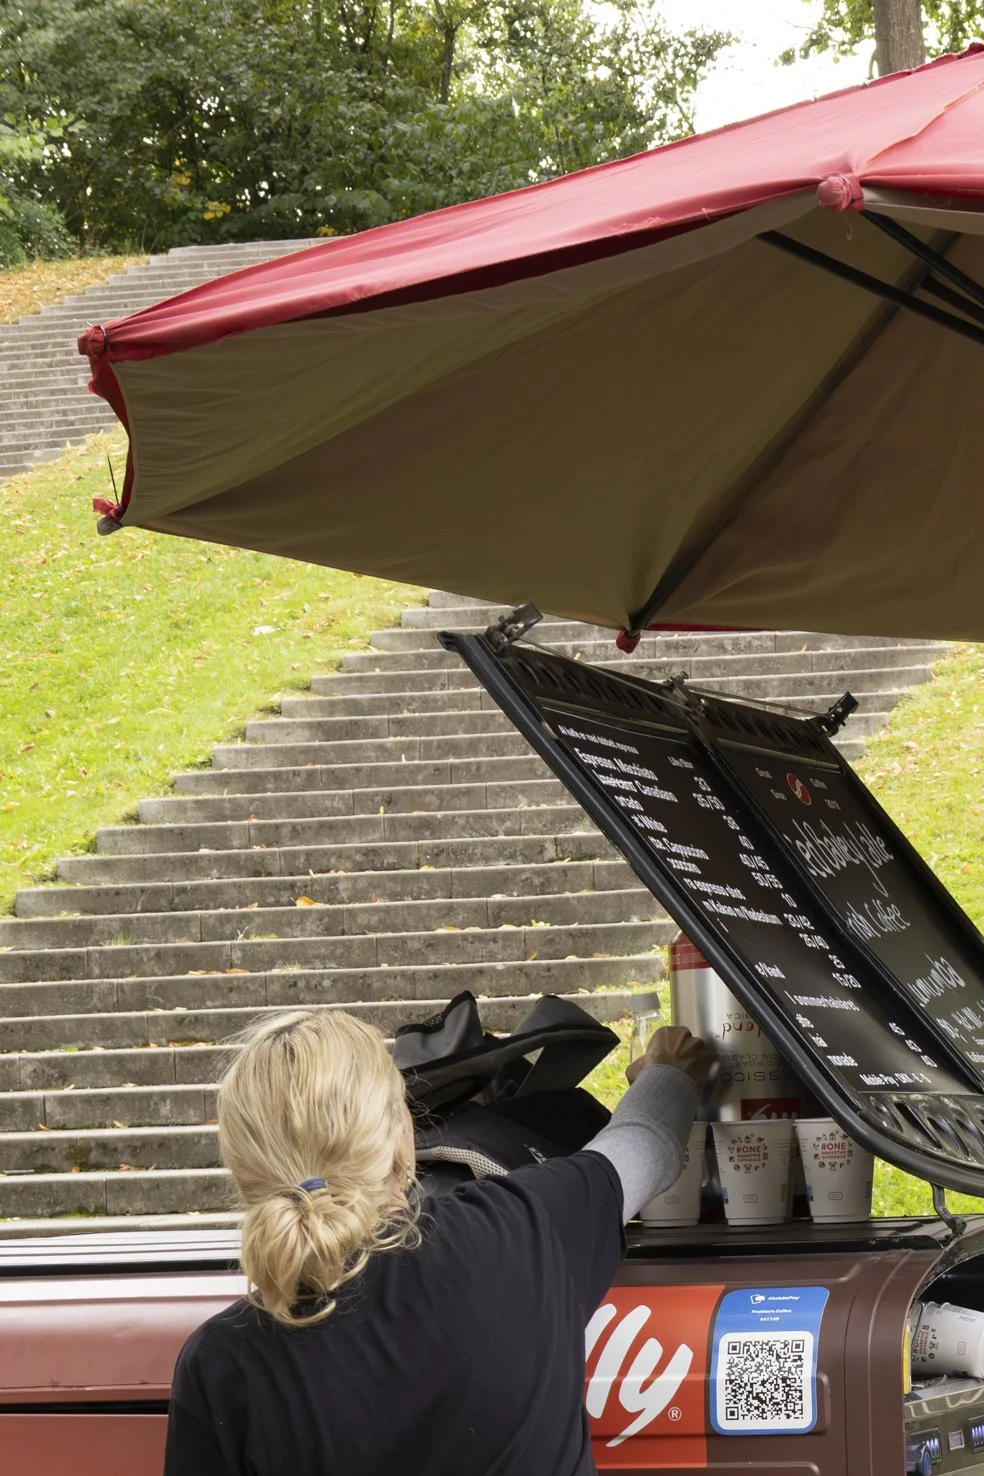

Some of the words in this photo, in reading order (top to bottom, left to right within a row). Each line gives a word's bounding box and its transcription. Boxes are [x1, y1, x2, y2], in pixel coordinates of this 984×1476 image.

[573, 747, 621, 773] Espresso,
[613, 757, 659, 781] Macchiato
[693, 776, 712, 792] 33
[634, 779, 678, 803] Canadiano
[692, 792, 726, 811] 35/50
[614, 795, 644, 812] ortado
[722, 815, 740, 831] 38
[636, 813, 668, 833] White
[738, 835, 755, 850] 40
[843, 821, 894, 869] Latte
[647, 835, 670, 853] tte,
[661, 837, 710, 861] Cappuccino
[738, 853, 770, 871] 40/45
[784, 819, 836, 878] ed
[802, 819, 890, 898] Bailey
[693, 879, 730, 897] espresso
[780, 893, 798, 908] 10
[750, 871, 784, 889] 50/55
[707, 898, 738, 917] Kakao
[783, 913, 815, 930] 33/42
[846, 901, 882, 942] rish
[863, 898, 911, 933] Coffee
[798, 933, 830, 950] 35/40
[828, 954, 846, 969] 25
[831, 972, 862, 989] 15/20
[888, 1022, 906, 1036] 45
[904, 1039, 922, 1053] 43
[920, 1055, 938, 1068] 40
[859, 1073, 886, 1086] Mobile
[878, 1073, 900, 1087] Pay
[736, 1145, 761, 1153] #ONE
[821, 1142, 846, 1150] #ONE
